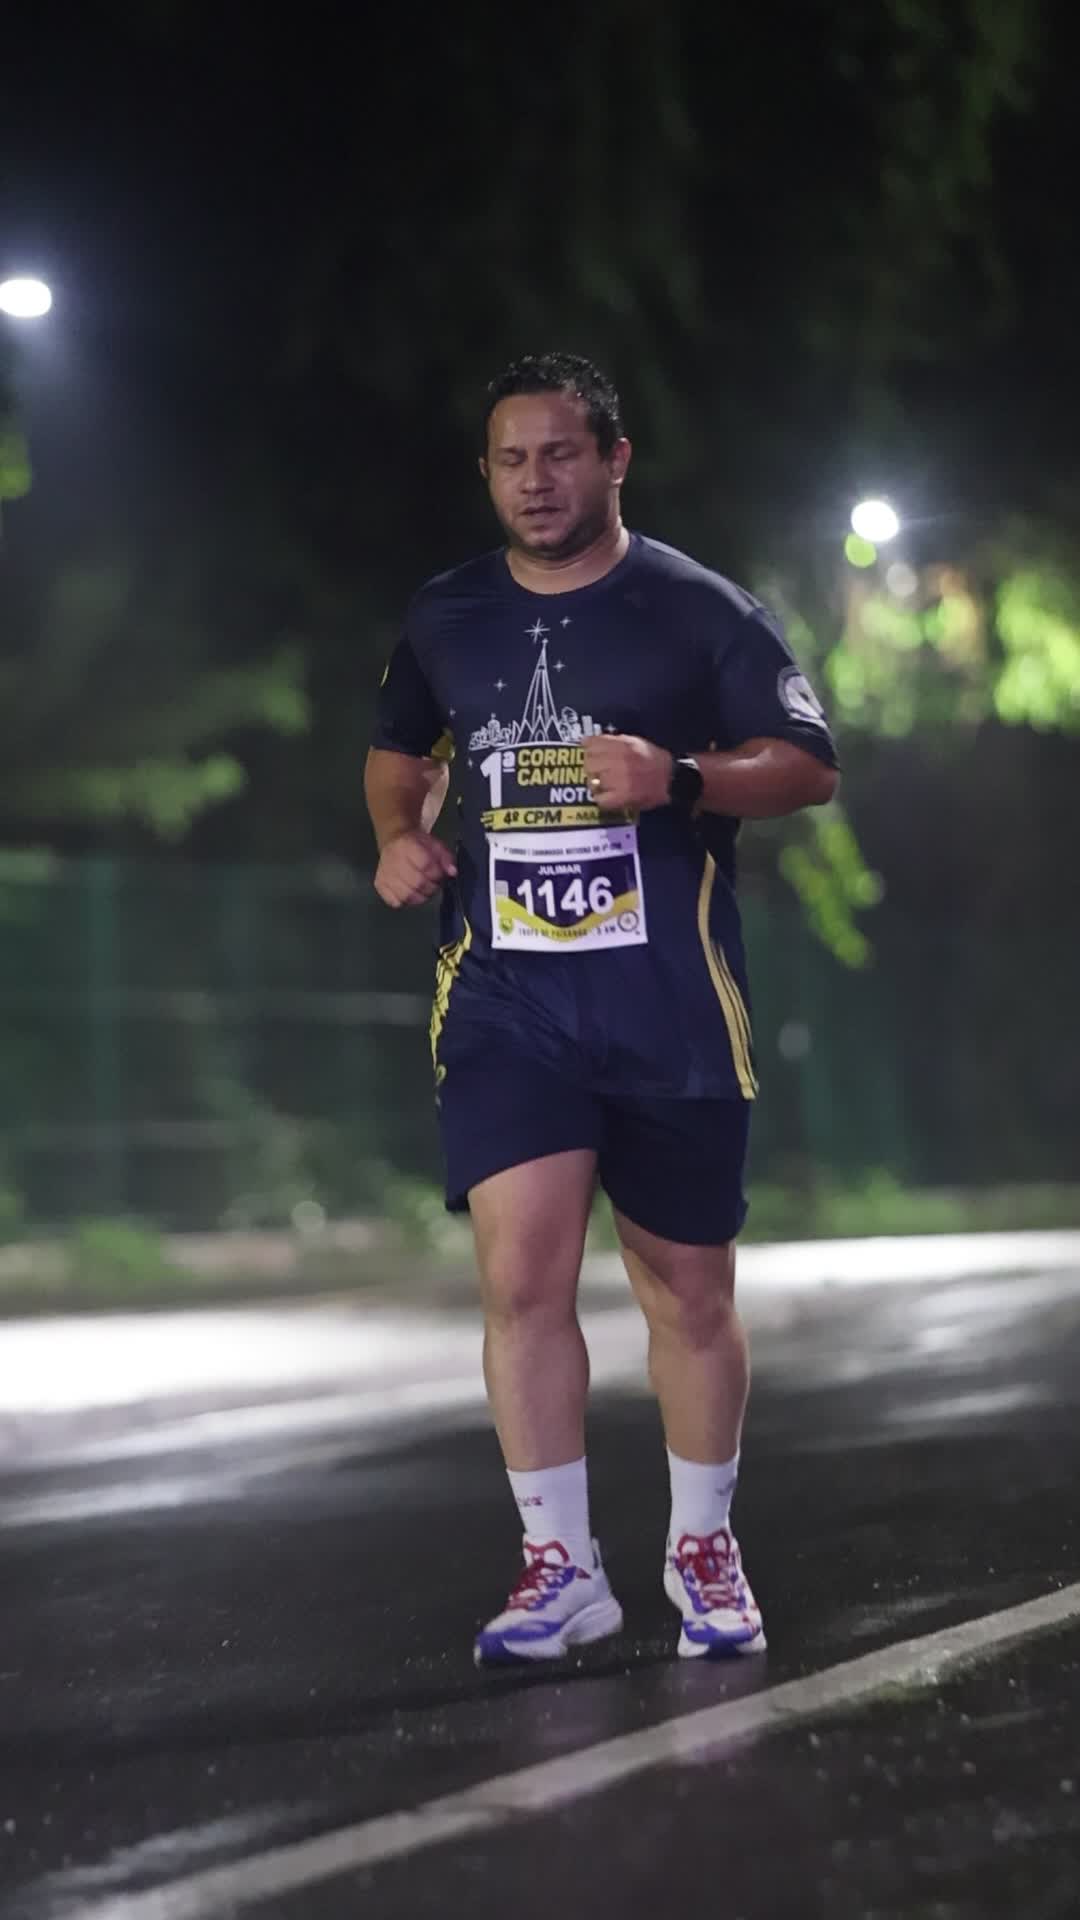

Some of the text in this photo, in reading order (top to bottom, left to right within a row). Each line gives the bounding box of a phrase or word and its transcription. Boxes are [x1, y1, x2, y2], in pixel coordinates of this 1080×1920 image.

[480, 751, 515, 808] 1ª
[524, 809, 562, 824] CPM
[538, 864, 582, 875] JULIMAR
[517, 876, 614, 918] 1146
